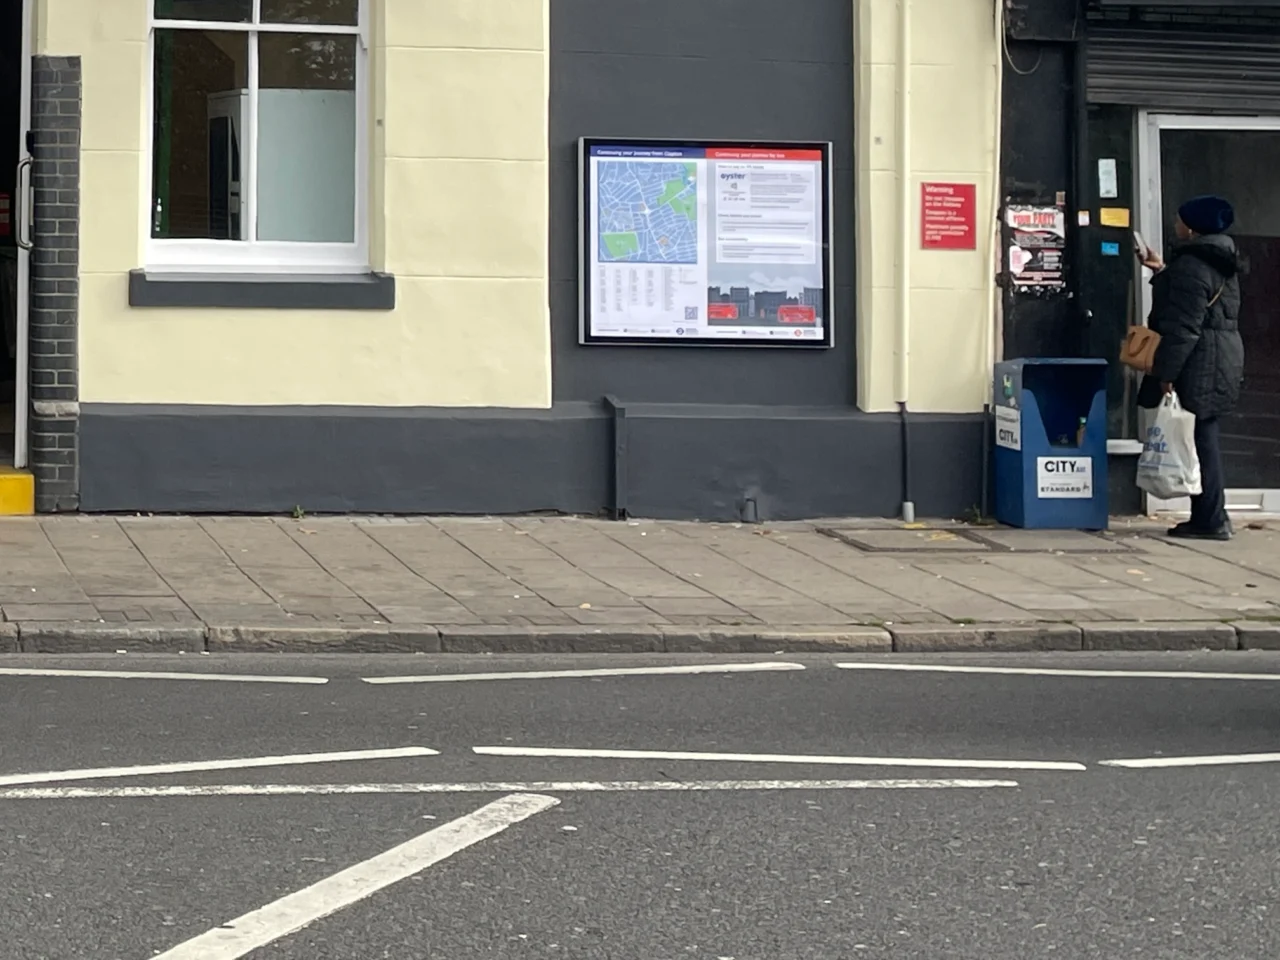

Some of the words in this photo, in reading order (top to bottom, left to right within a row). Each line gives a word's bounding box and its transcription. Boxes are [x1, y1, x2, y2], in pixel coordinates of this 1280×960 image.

[720, 172, 746, 180] oyster
[924, 184, 954, 195] Warning
[998, 427, 1014, 444] CITY
[1044, 460, 1077, 473] CITY
